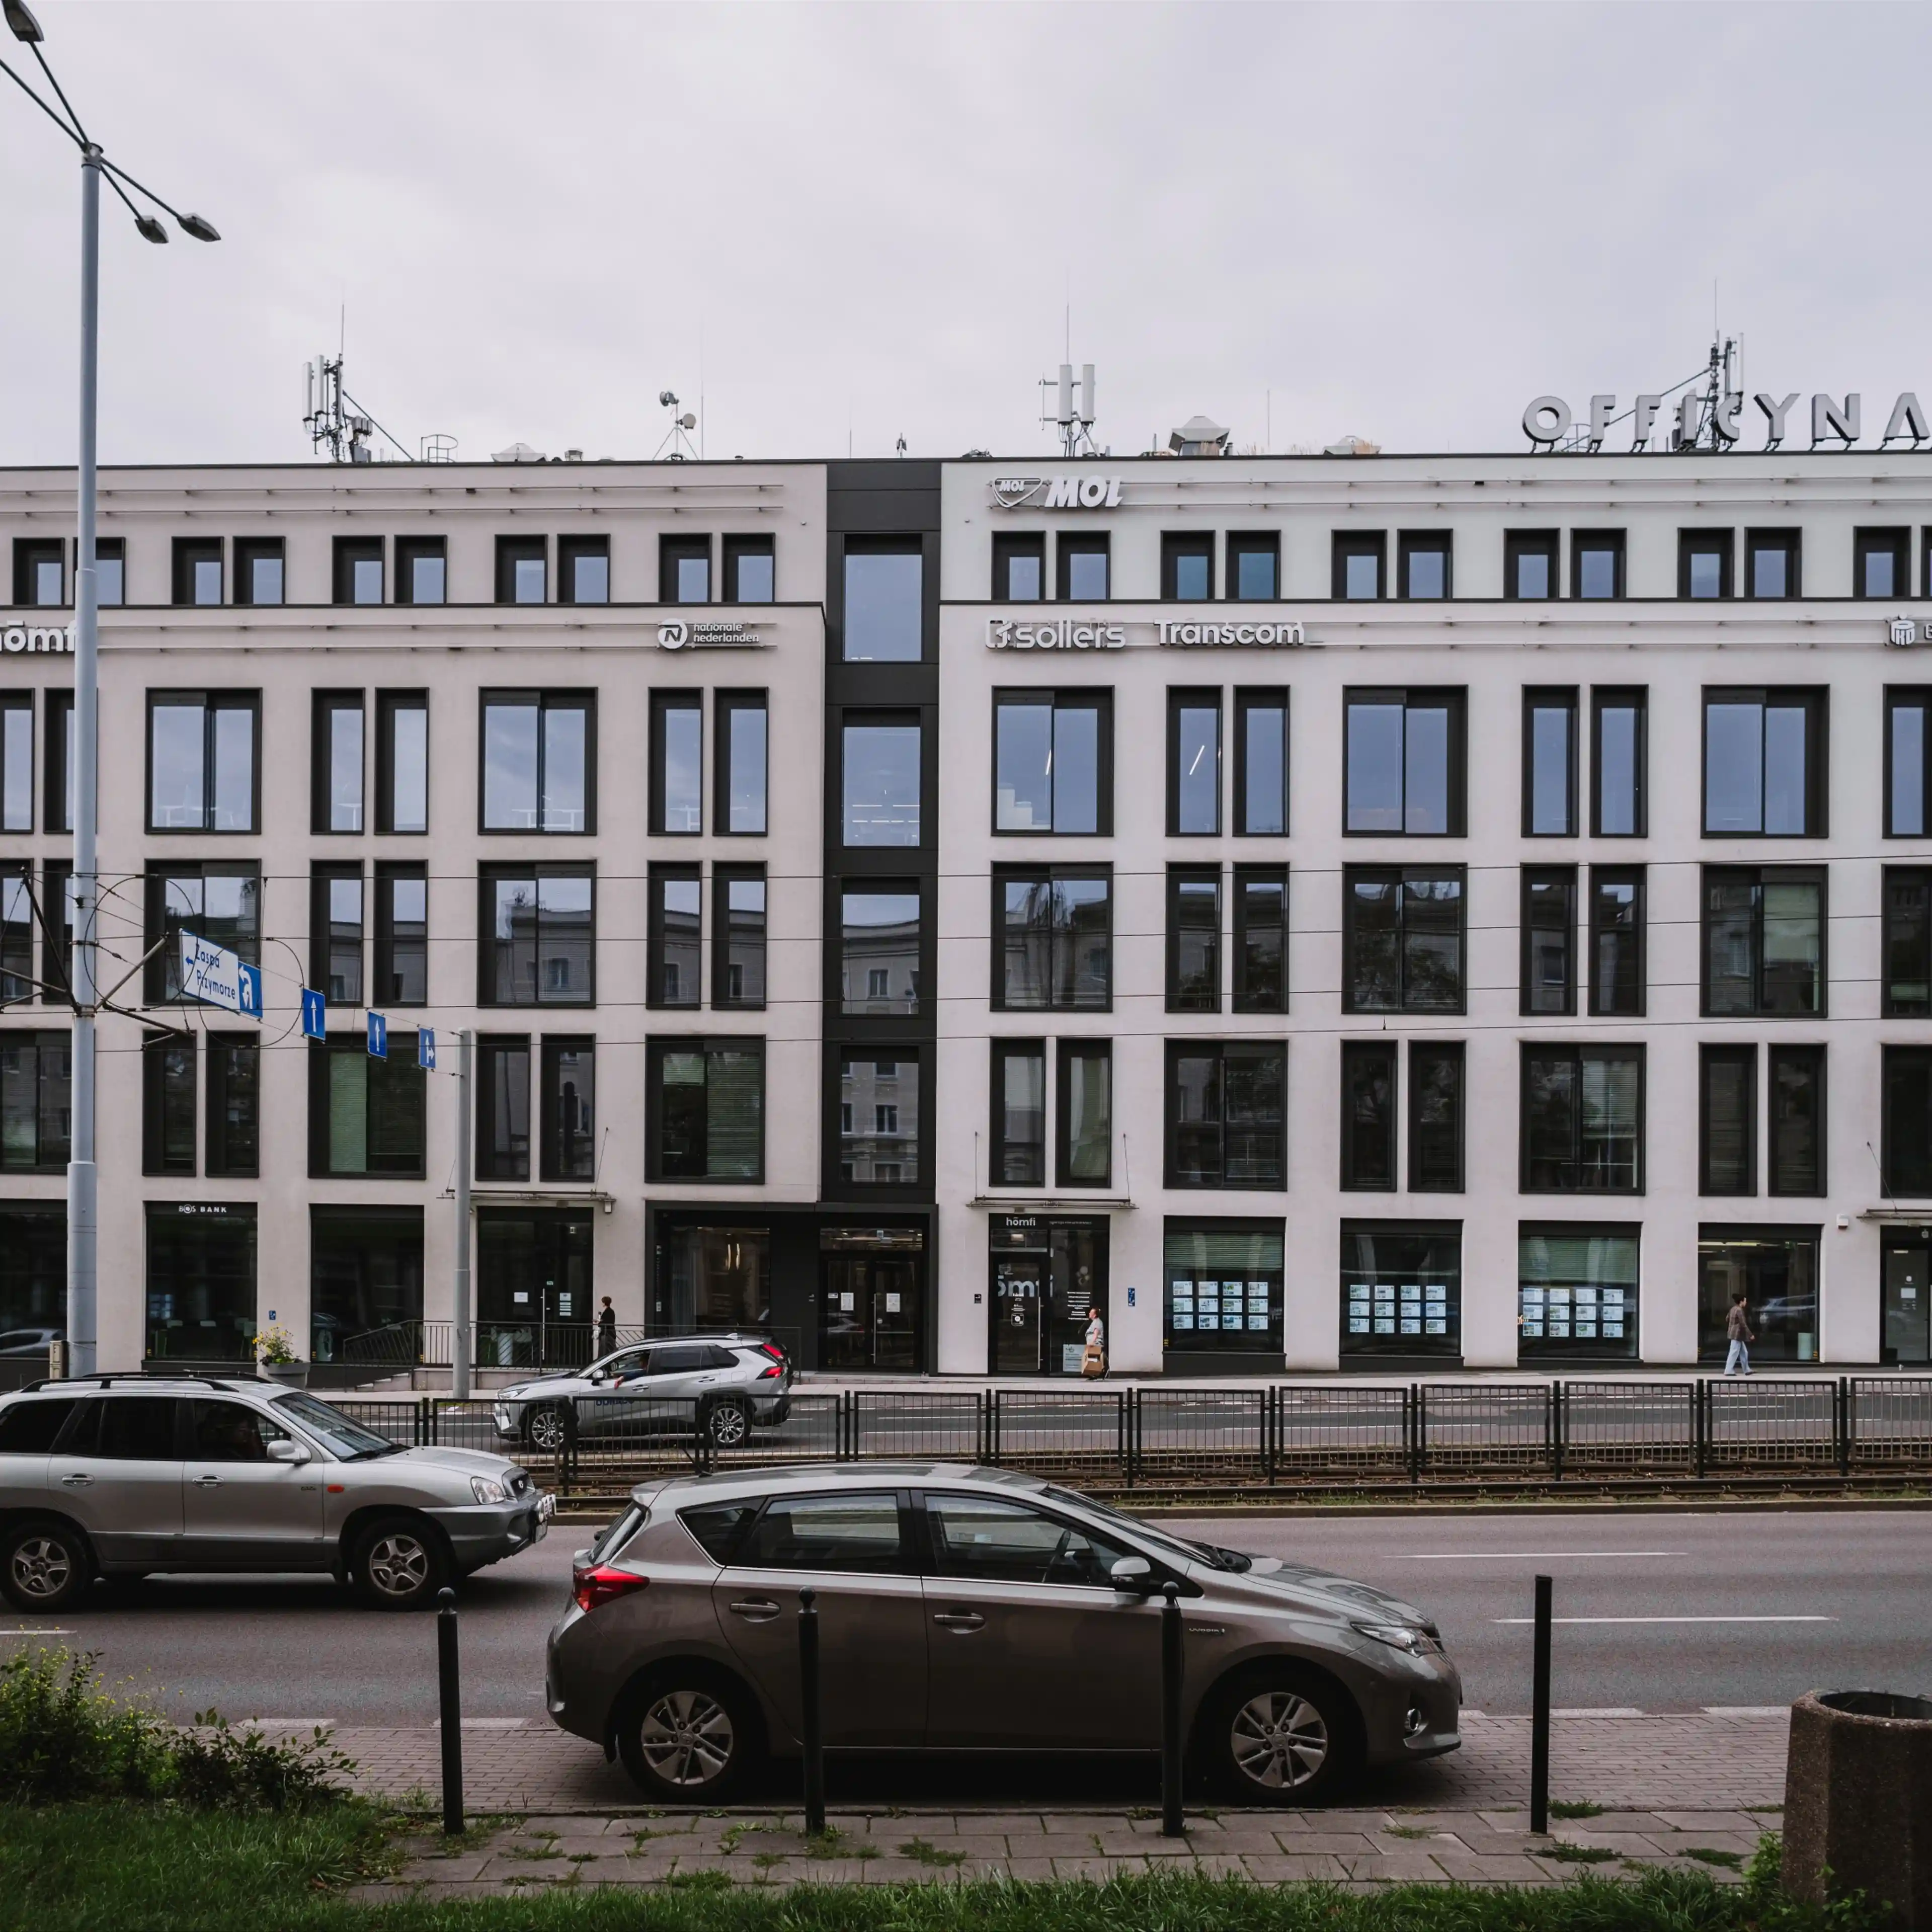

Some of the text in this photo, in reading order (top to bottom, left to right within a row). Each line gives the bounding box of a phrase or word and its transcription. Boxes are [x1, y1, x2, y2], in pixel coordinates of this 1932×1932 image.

[1522, 392, 1931, 445] OFFICYNA
[999, 480, 1025, 493] MOL
[1044, 475, 1123, 507] MOL
[693, 623, 743, 632] nationale
[693, 632, 759, 642] nederlanden
[1015, 620, 1126, 649] sollers
[1154, 618, 1305, 645] Transcom
[196, 969, 235, 1000] Przymorze
